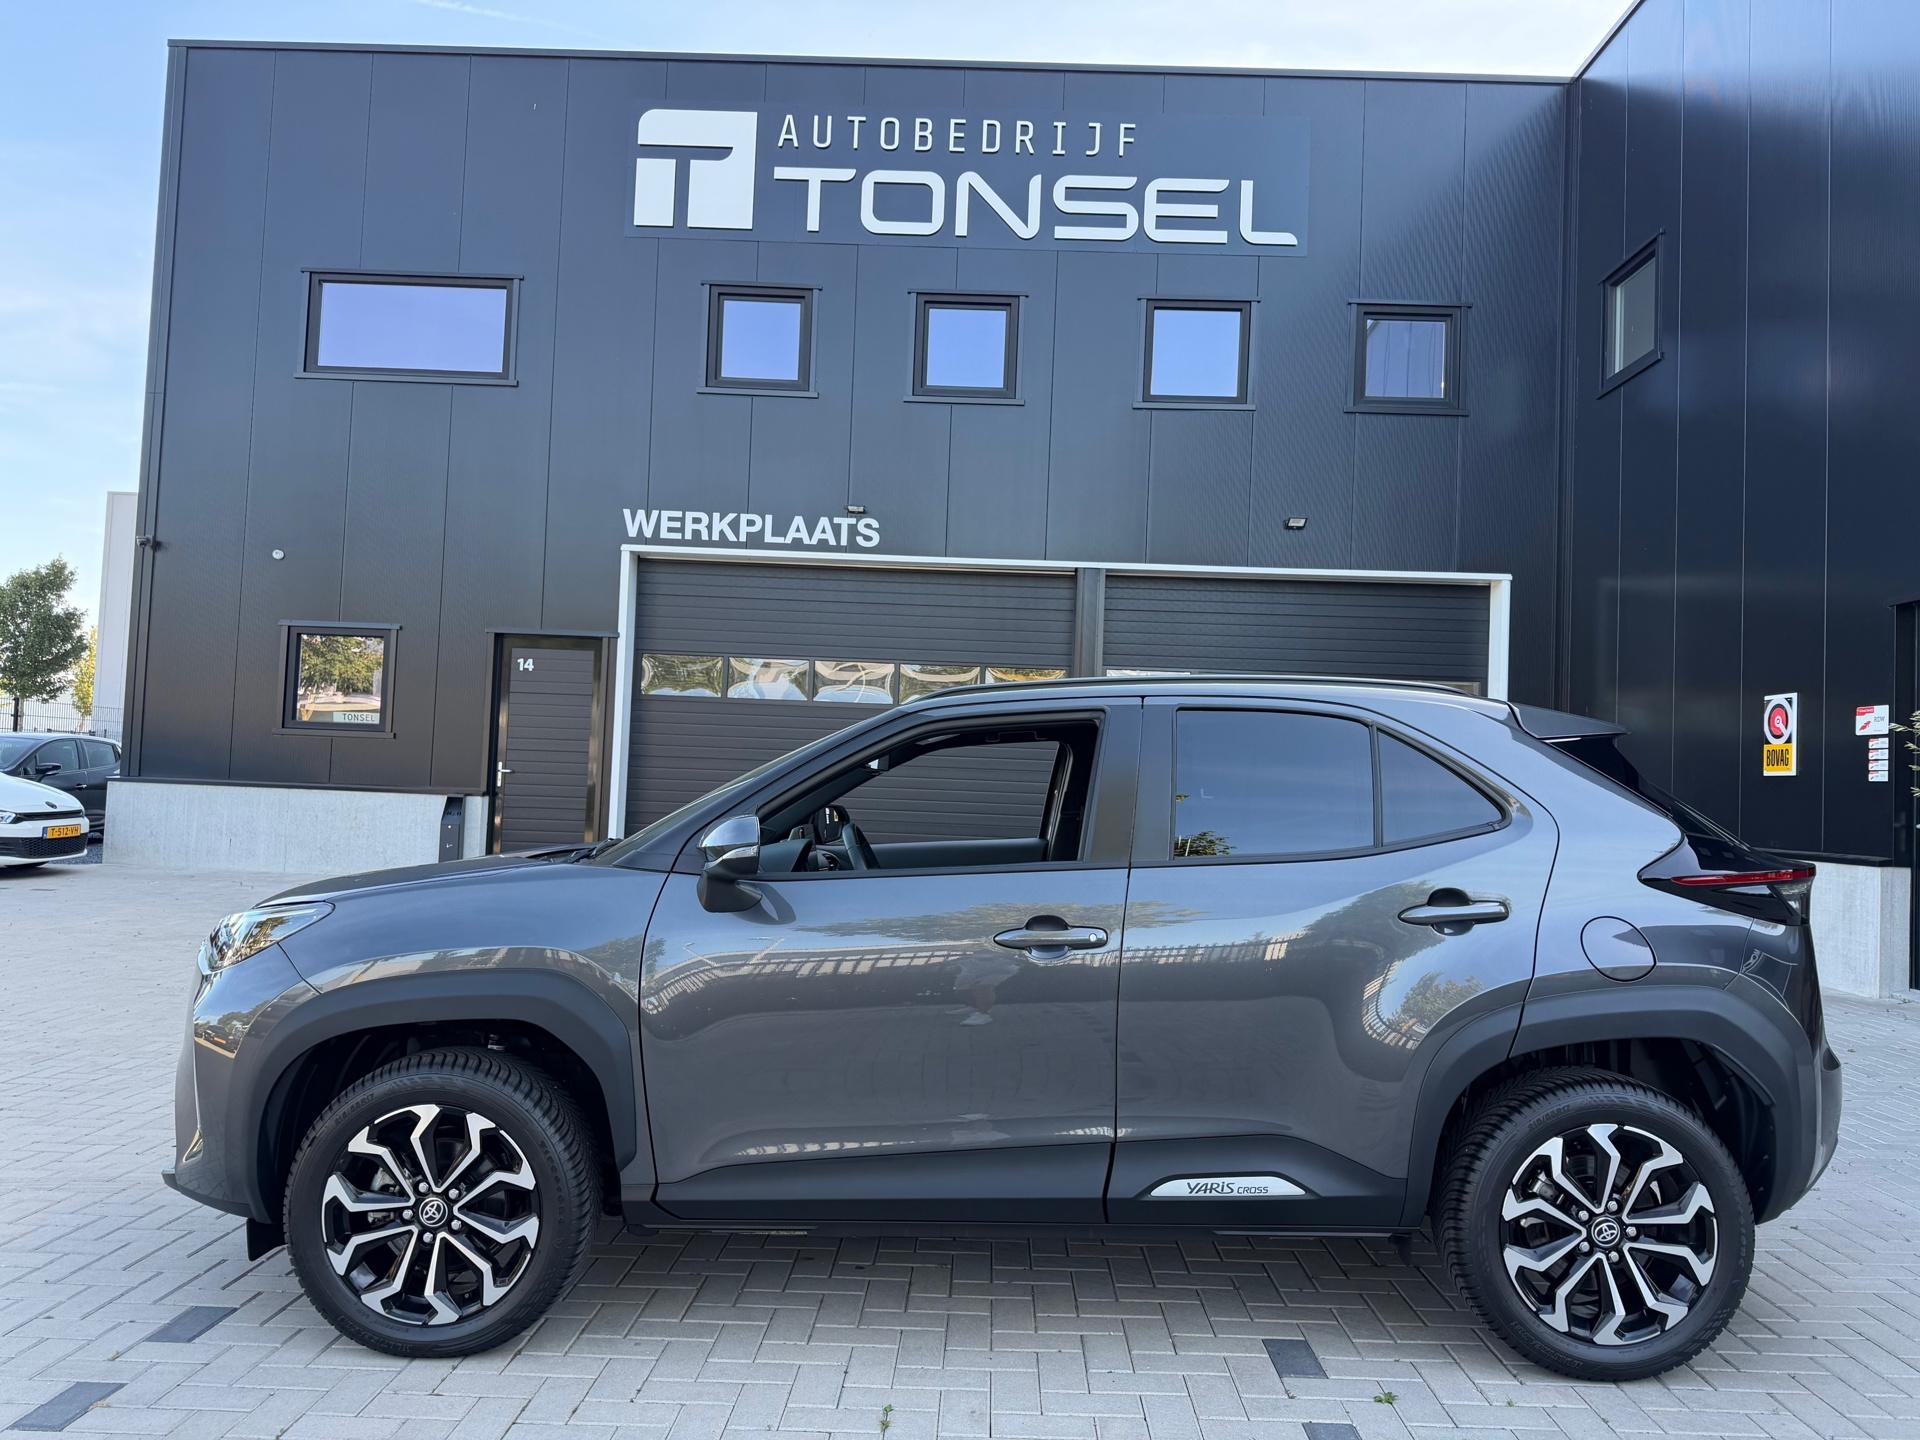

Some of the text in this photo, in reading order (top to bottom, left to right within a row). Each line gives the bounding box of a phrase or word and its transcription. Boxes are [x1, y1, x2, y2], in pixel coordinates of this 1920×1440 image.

[777, 114, 1138, 157] AUTOBEDRIJF
[773, 166, 1299, 247] TONSEL
[622, 508, 881, 548] WERKPLAATS
[517, 658, 535, 671] 14
[343, 713, 376, 722] TONSEL
[1766, 749, 1790, 767] BOVAG
[1237, 1186, 1269, 1195] CROSS
